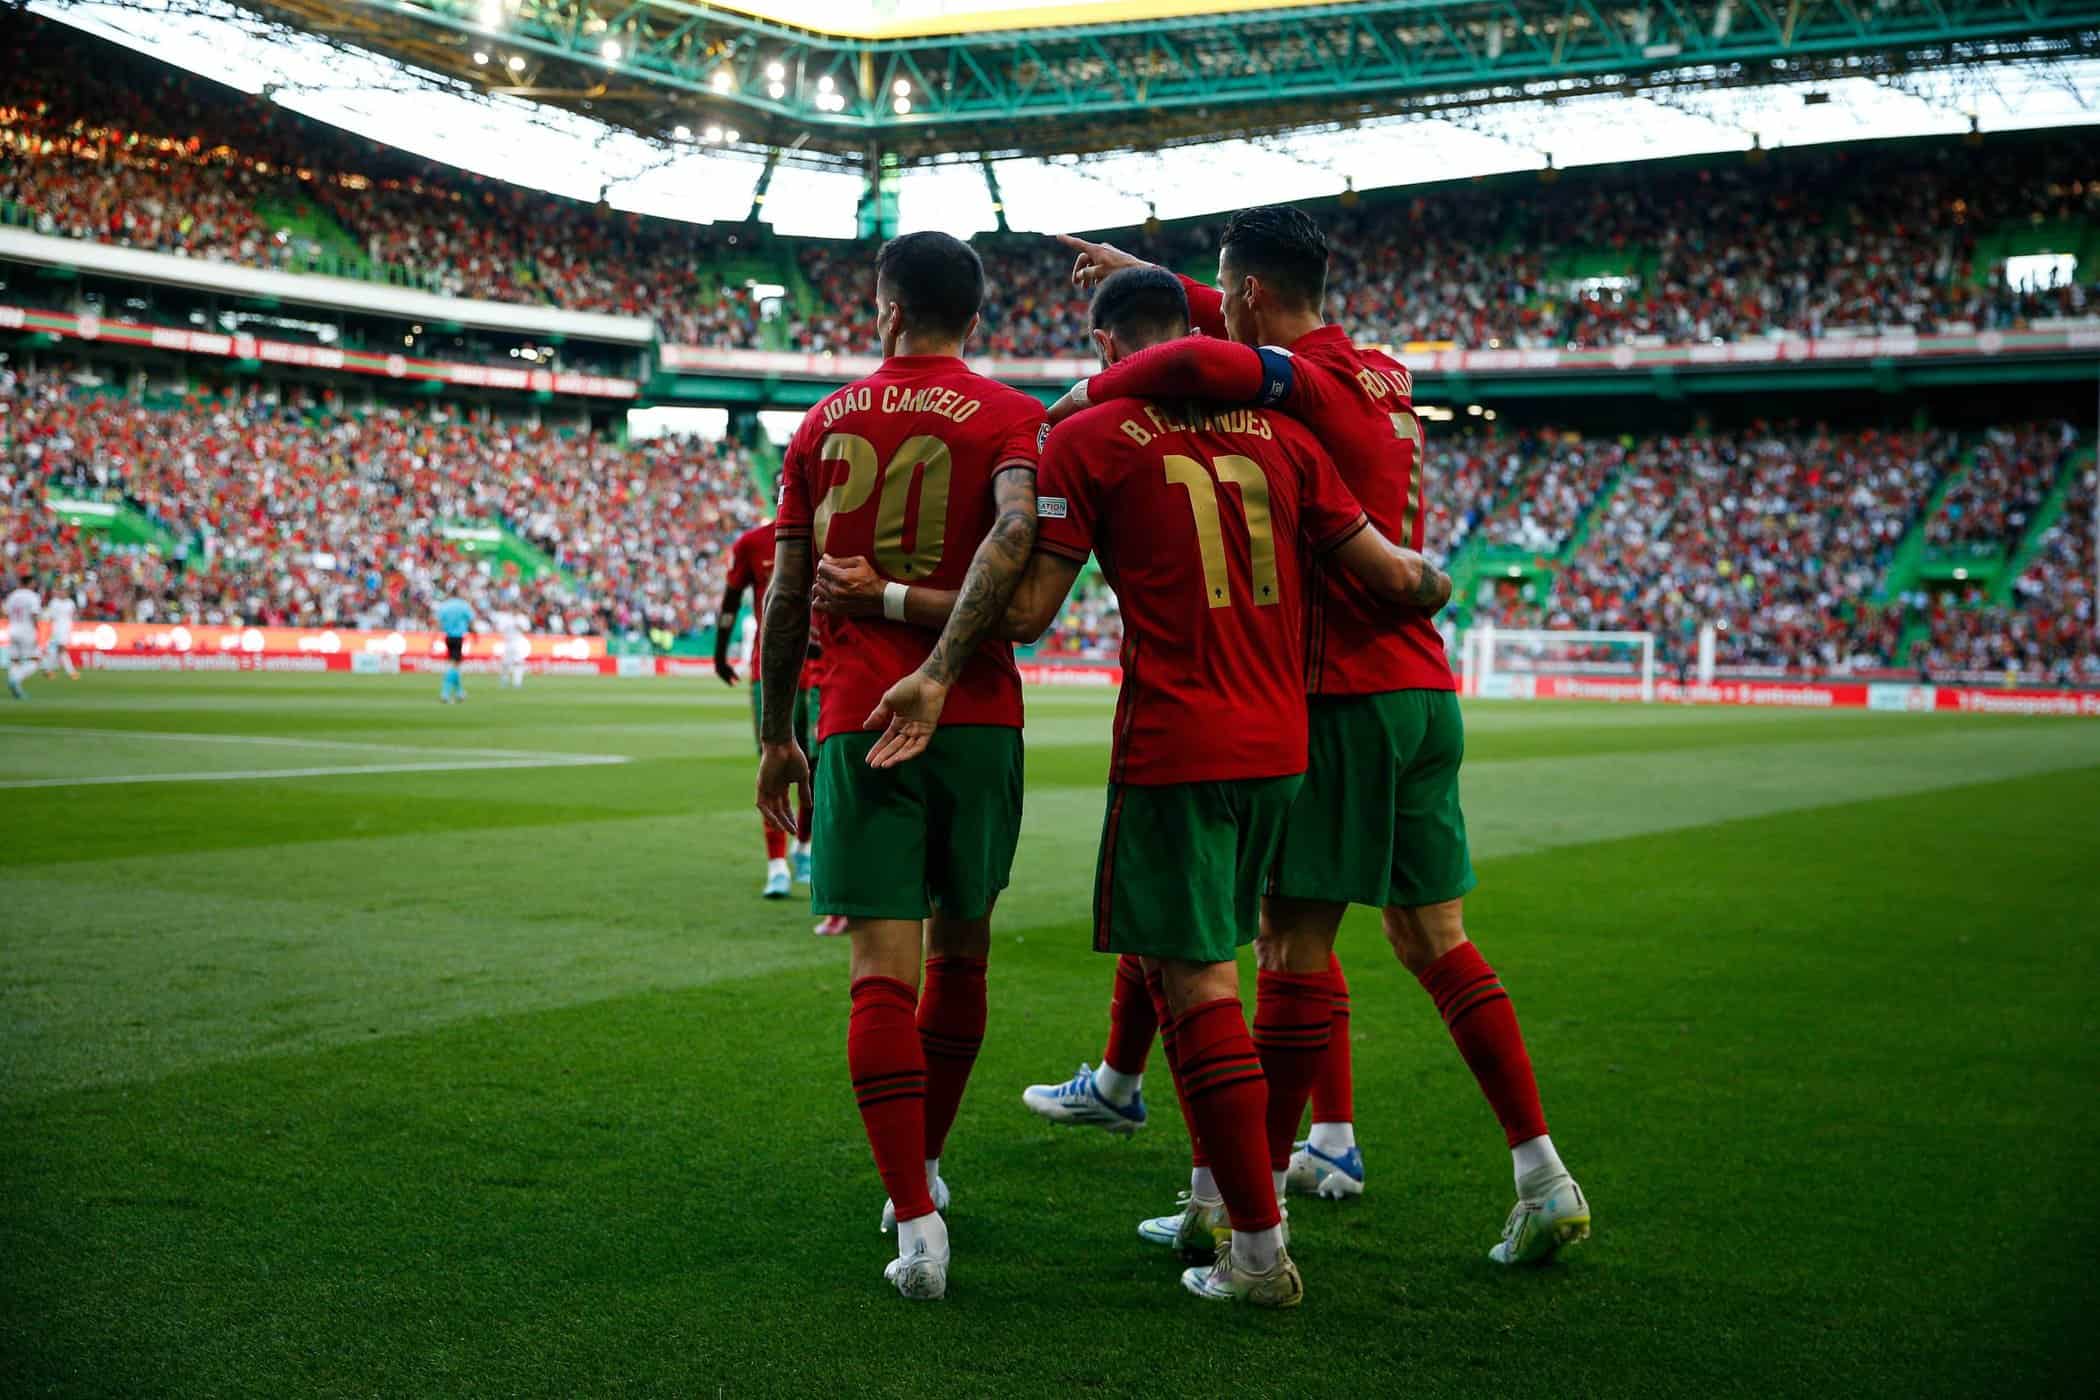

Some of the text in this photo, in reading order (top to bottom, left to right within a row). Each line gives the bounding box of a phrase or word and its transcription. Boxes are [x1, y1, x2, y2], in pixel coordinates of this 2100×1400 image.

[822, 385, 981, 428] JOÃO CANCELO
[1120, 405, 1273, 448] B.FEANDES
[1355, 368, 1413, 404] ROLDO
[813, 432, 953, 581] 20
[1388, 412, 1422, 548] 7
[1162, 453, 1280, 609] 11
